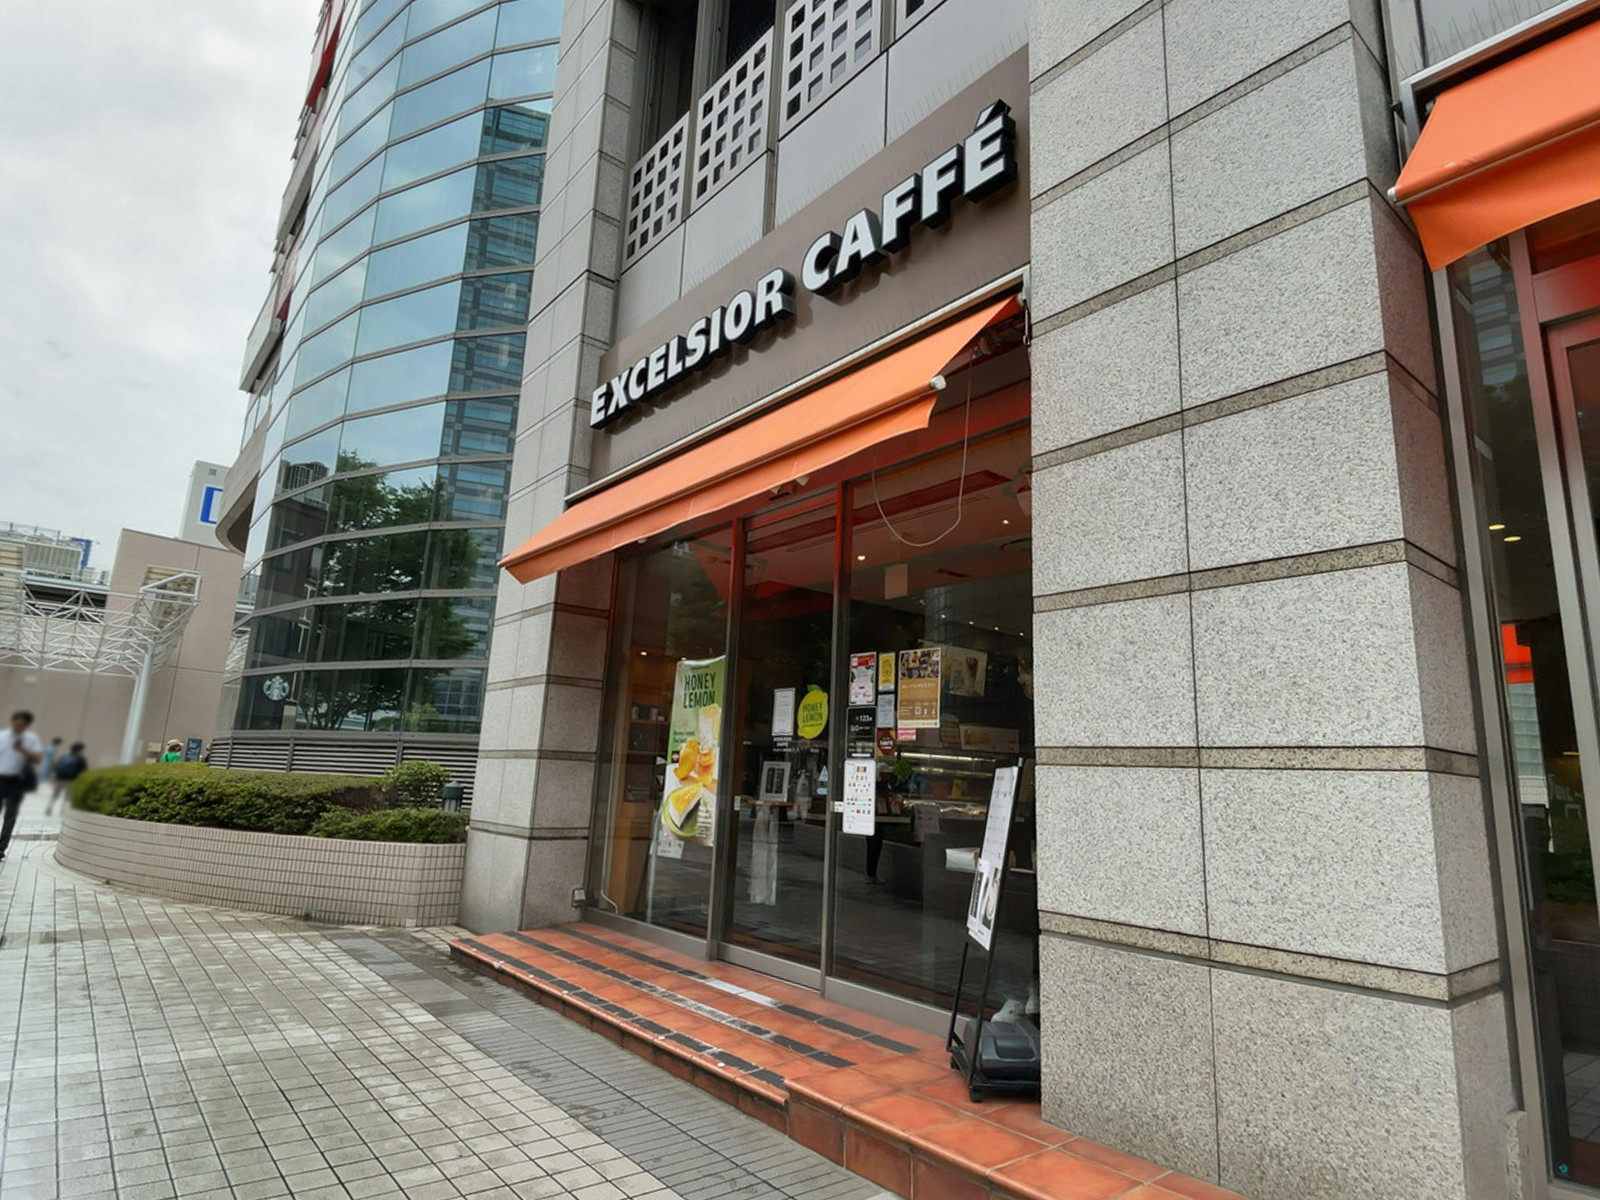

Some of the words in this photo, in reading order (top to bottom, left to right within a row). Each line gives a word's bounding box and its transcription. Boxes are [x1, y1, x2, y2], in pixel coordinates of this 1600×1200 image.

[590, 267, 789, 428] EXCELSIOR
[802, 99, 1011, 293] CAFFÉ
[684, 672, 717, 691] HONEY
[683, 690, 716, 709] LEMON
